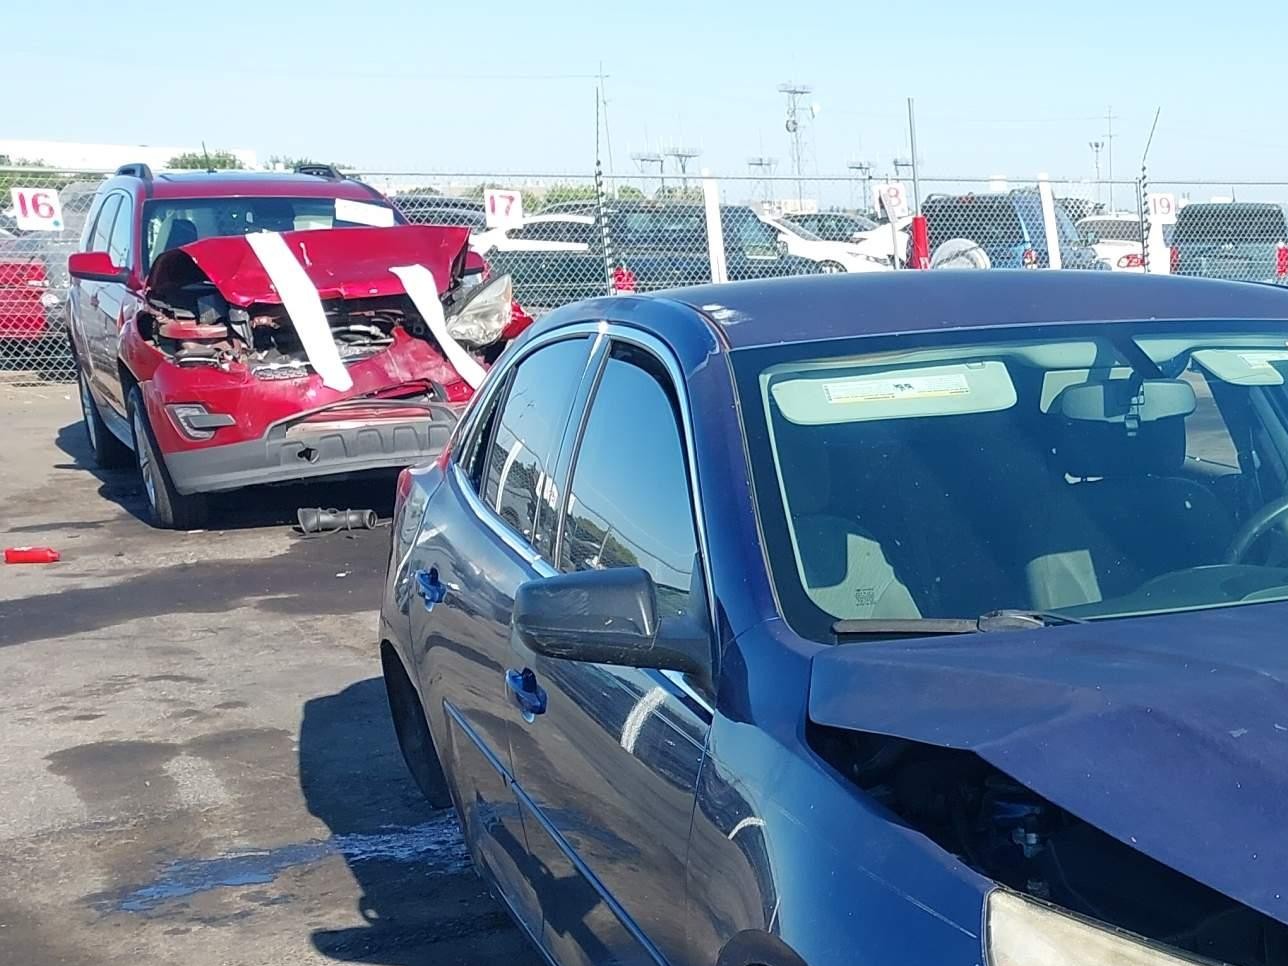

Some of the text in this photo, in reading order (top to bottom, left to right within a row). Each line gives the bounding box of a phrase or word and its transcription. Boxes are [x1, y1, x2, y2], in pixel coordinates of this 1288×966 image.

[17, 192, 55, 219] 16
[489, 194, 515, 216] 17
[1153, 197, 1171, 215] 19
